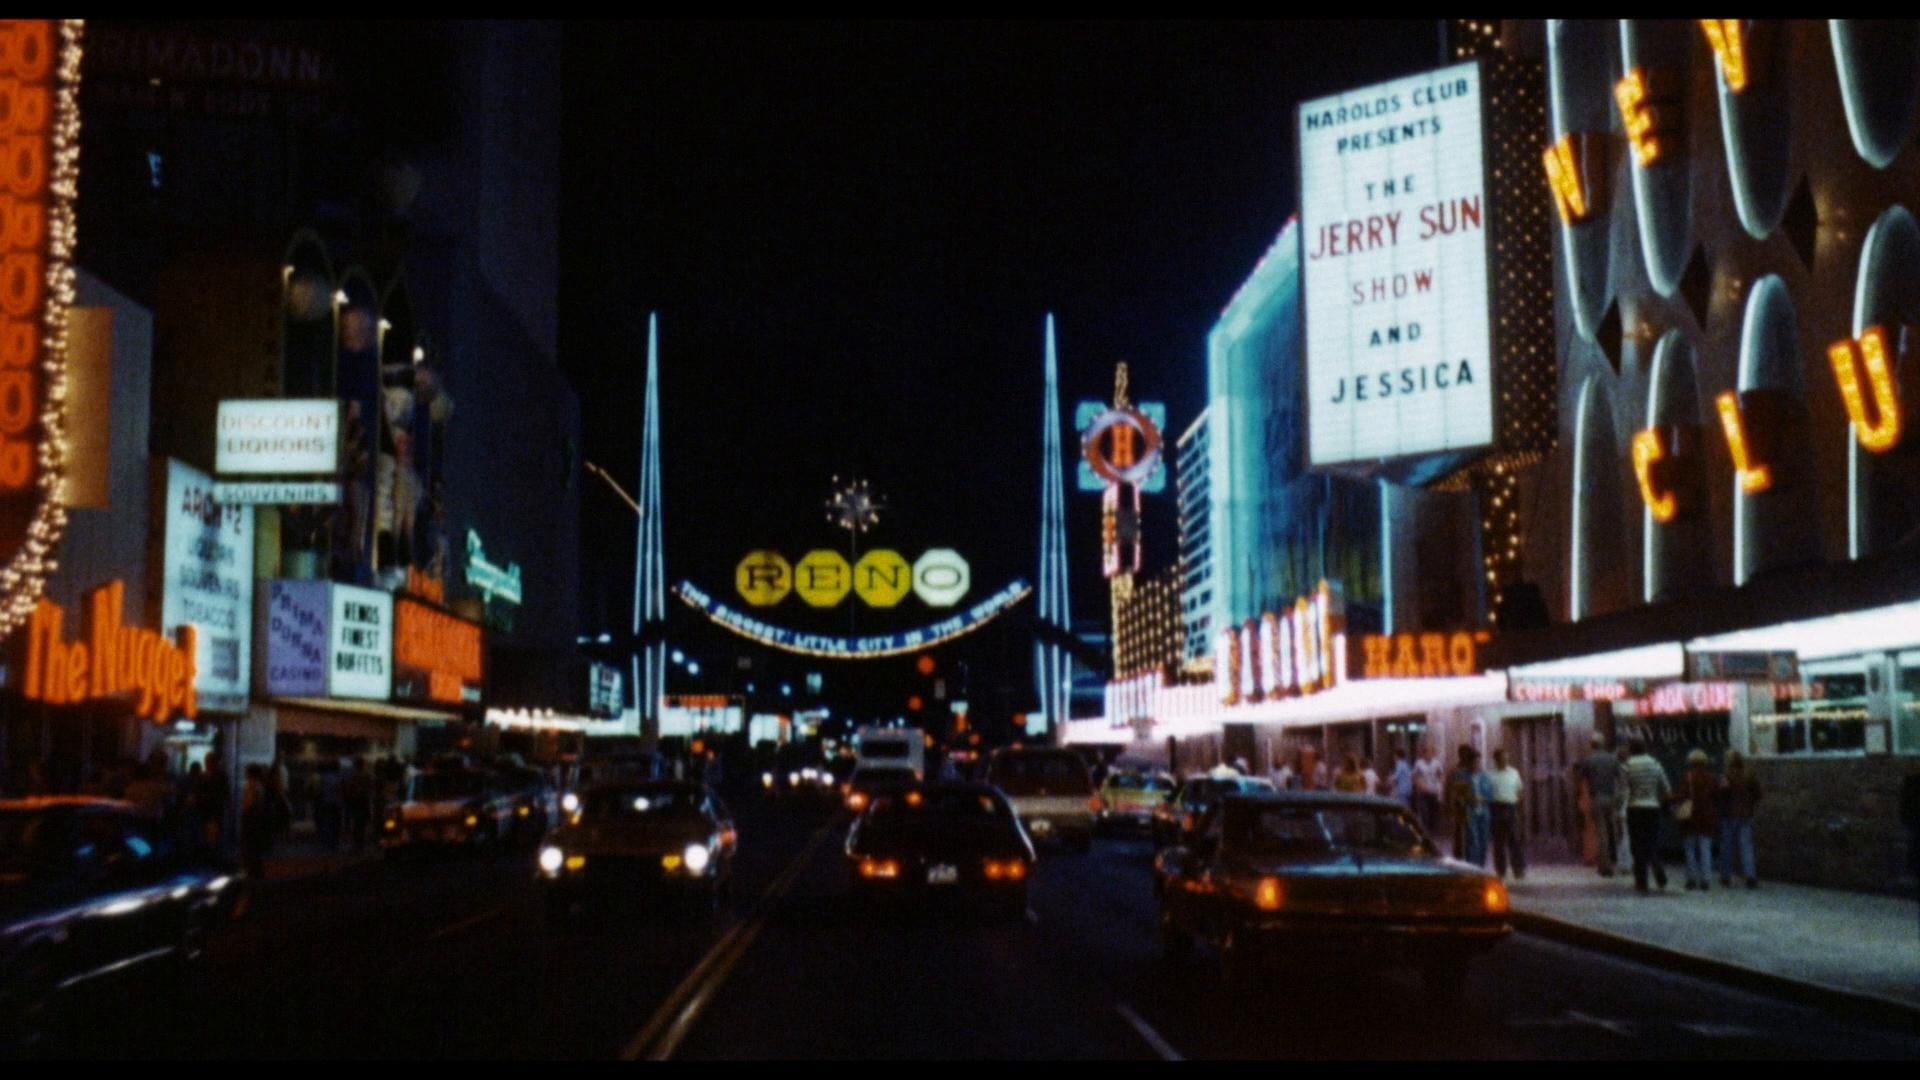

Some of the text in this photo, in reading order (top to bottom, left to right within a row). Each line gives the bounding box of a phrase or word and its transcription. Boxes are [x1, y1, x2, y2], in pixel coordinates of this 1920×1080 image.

[1306, 78, 1468, 130] HAROLDS CLUB
[1336, 116, 1441, 154] PRESENTS
[1364, 174, 1415, 201] THE
[1309, 194, 1481, 261] JERRY SUN
[1352, 267, 1433, 306] SHOW
[1369, 322, 1421, 347] AND
[1330, 357, 1474, 405] JESSICA
[222, 414, 332, 431] DISCOUNT
[226, 436, 326, 455] LIQUORS
[222, 487, 329, 502] SOUVENIRS
[743, 560, 964, 596] RENO
[344, 601, 380, 626] RENOS
[682, 580, 1023, 652] THE BIGGEST LITTLE CITY IN THE WORLD
[24, 579, 198, 723] The Nugget
[342, 628, 380, 650] FINEST
[271, 667, 322, 682] CASINO
[336, 651, 384, 676] BUFFETS
[1583, 681, 1627, 700] SHOP
